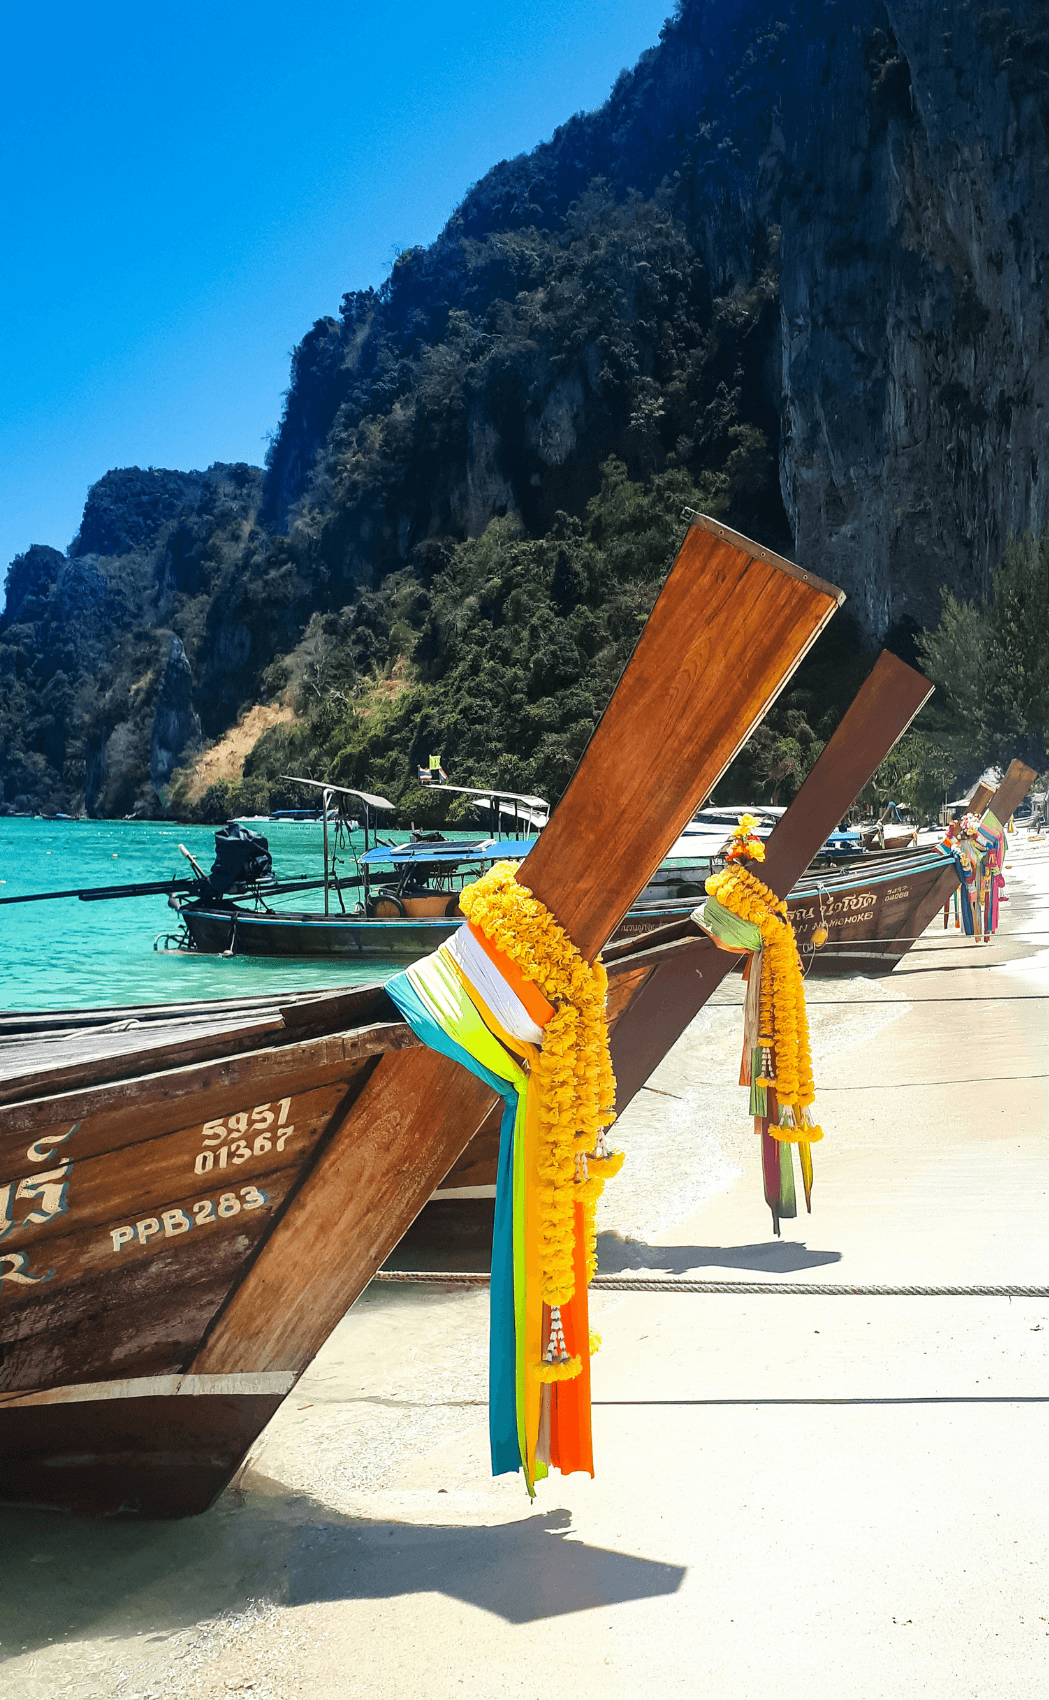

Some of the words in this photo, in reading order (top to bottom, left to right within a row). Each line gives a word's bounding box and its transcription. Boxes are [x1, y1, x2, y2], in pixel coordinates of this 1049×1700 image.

[202, 1096, 292, 1147] 5951
[194, 1124, 295, 1175] 01367
[110, 1185, 269, 1252] PPB283
